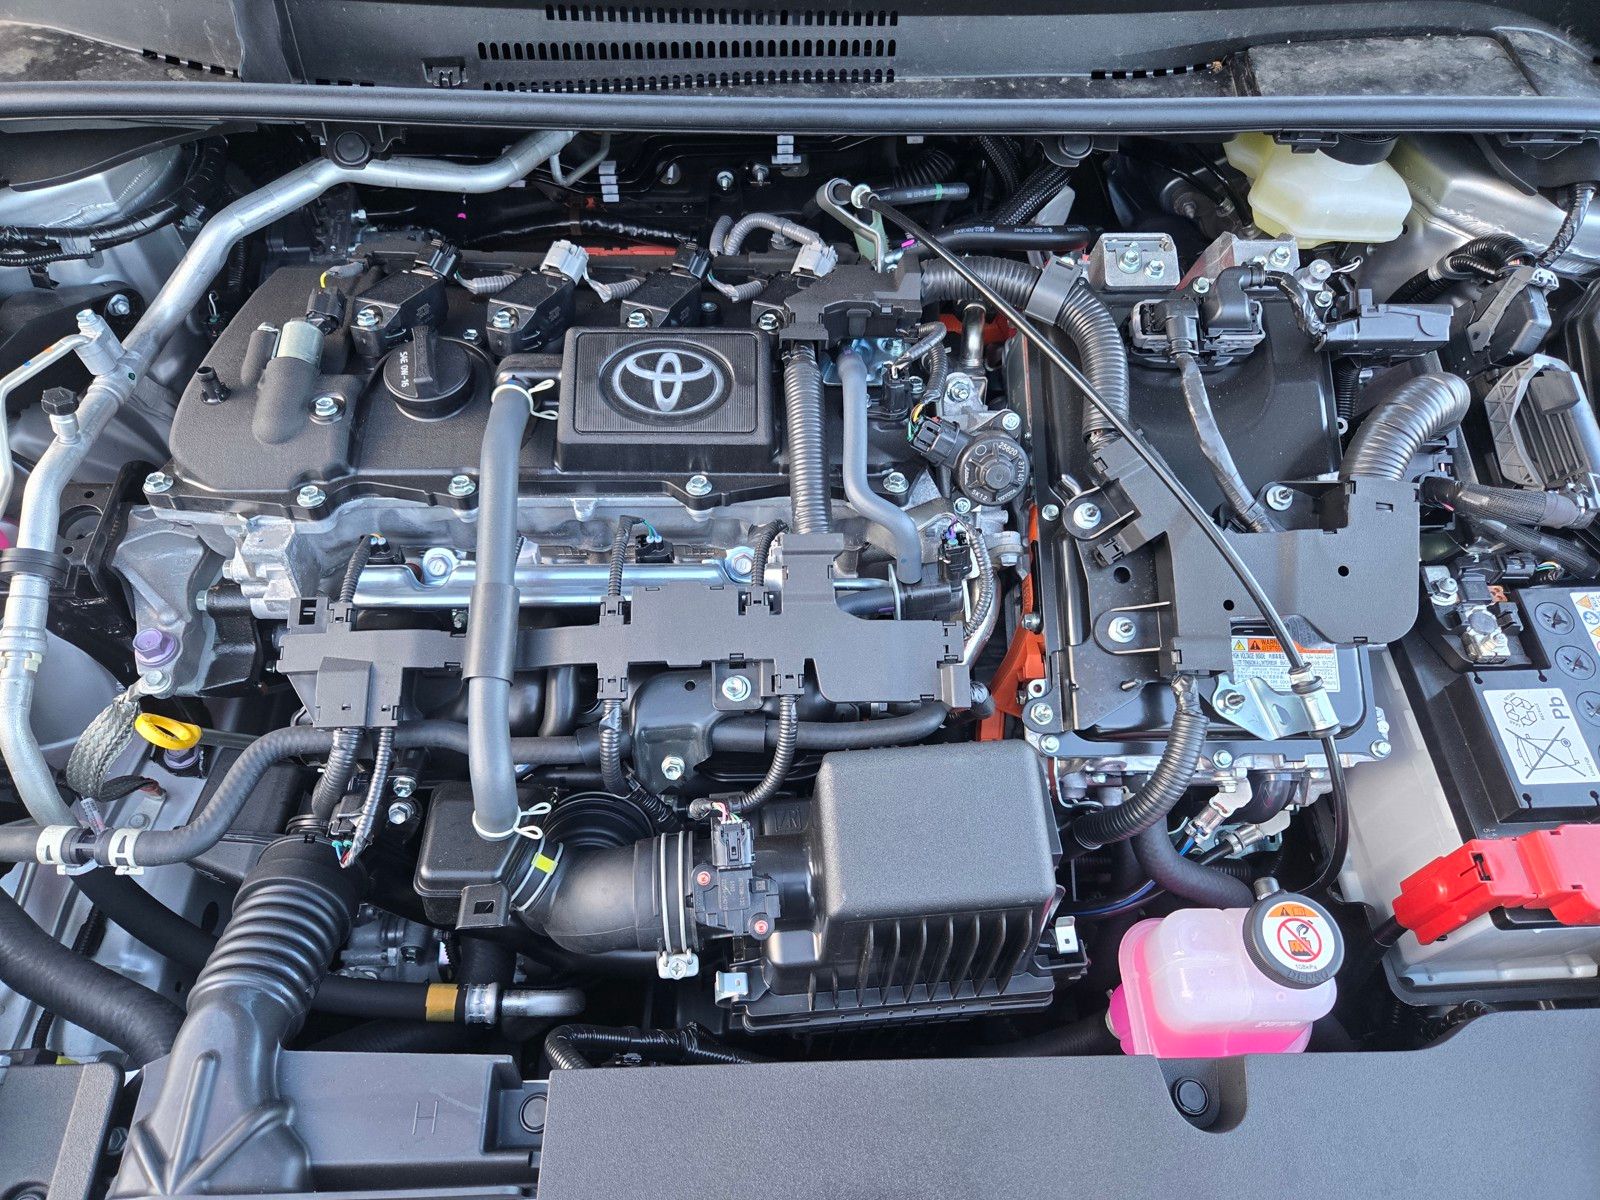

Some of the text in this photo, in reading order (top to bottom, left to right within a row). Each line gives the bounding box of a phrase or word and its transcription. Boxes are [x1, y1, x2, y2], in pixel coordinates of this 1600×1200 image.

[400, 351, 410, 388] SAE 0W-16
[998, 442, 1018, 456] 25620
[1017, 461, 1025, 482] 37140
[971, 489, 988, 501] 5K12
[1549, 697, 1570, 719] Pb
[411, 1101, 439, 1136] H
